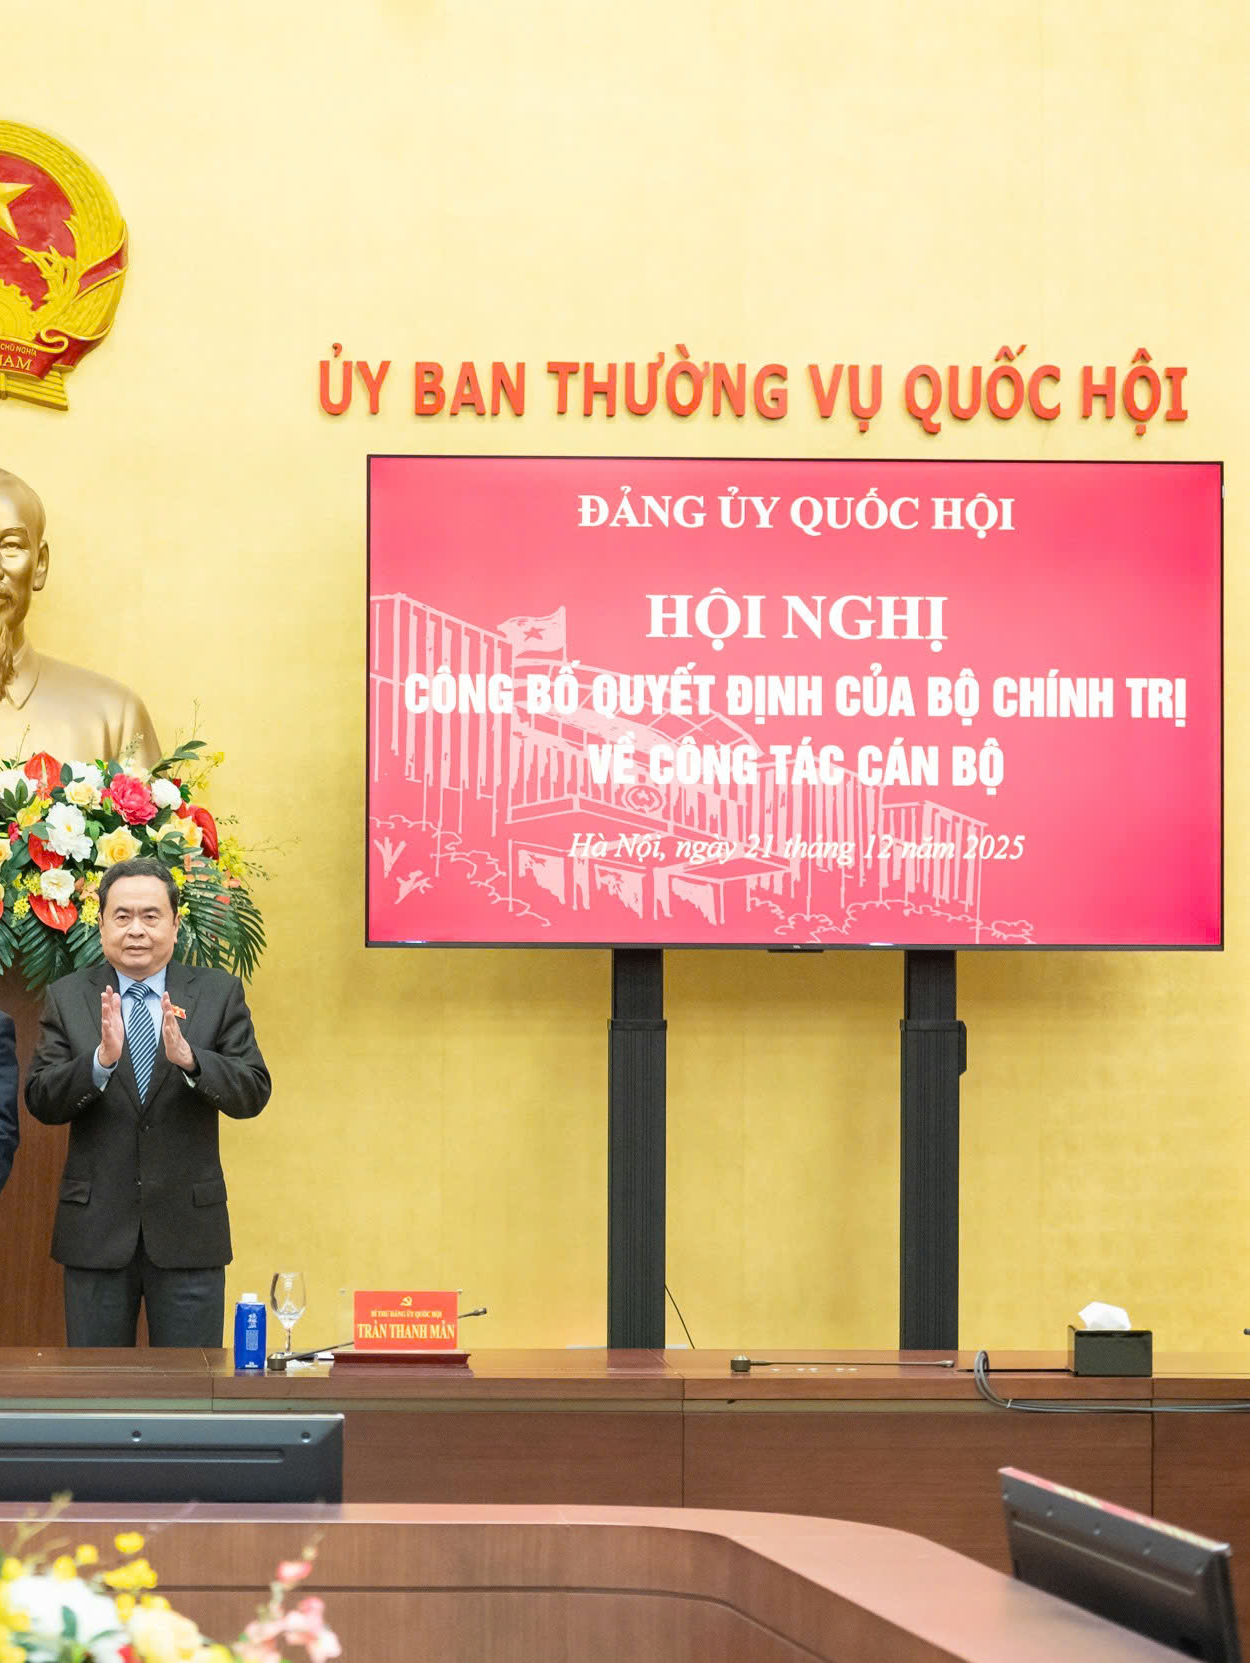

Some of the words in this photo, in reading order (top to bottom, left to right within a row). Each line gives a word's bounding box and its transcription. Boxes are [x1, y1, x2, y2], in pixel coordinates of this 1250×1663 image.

[319, 342, 392, 417] ỦY
[414, 361, 526, 417] BAN
[547, 343, 789, 420] THƯỜNG
[809, 364, 883, 433] VỤ
[905, 344, 1062, 435] QUỐC
[1082, 347, 1189, 436] HỘI
[577, 484, 707, 528] ĐẢNG
[719, 486, 780, 529] ỦY
[790, 487, 920, 537] QUỐC
[931, 492, 1016, 539] HỘI
[645, 587, 767, 651] HỘI
[781, 594, 949, 653] NGHỊ
[404, 664, 514, 715] CÔNG
[526, 660, 581, 715] BỐ
[592, 662, 716, 719] QUYẾT
[726, 675, 823, 725] ĐỊNH
[835, 662, 916, 717] CỦA
[927, 668, 980, 726] BỘ
[993, 669, 1114, 718] CHÍNH
[1125, 678, 1187, 727] TRỊ
[588, 731, 636, 784] VỀ
[649, 735, 758, 785] CÔNG
[769, 736, 845, 786] TÁC
[857, 737, 939, 787] CÁN
[952, 737, 1004, 795] BỘ
[567, 832, 607, 858] Hà
[614, 832, 666, 862] Nội,
[675, 834, 738, 865] ngày
[745, 833, 775, 859] 21
[783, 833, 856, 866] tháng
[864, 834, 894, 859] 12
[901, 836, 955, 859] năm
[963, 834, 1026, 860] 2025
[357, 1319, 388, 1339] TRẦN
[389, 1323, 428, 1339] THANH
[429, 1319, 455, 1339] MẪN
